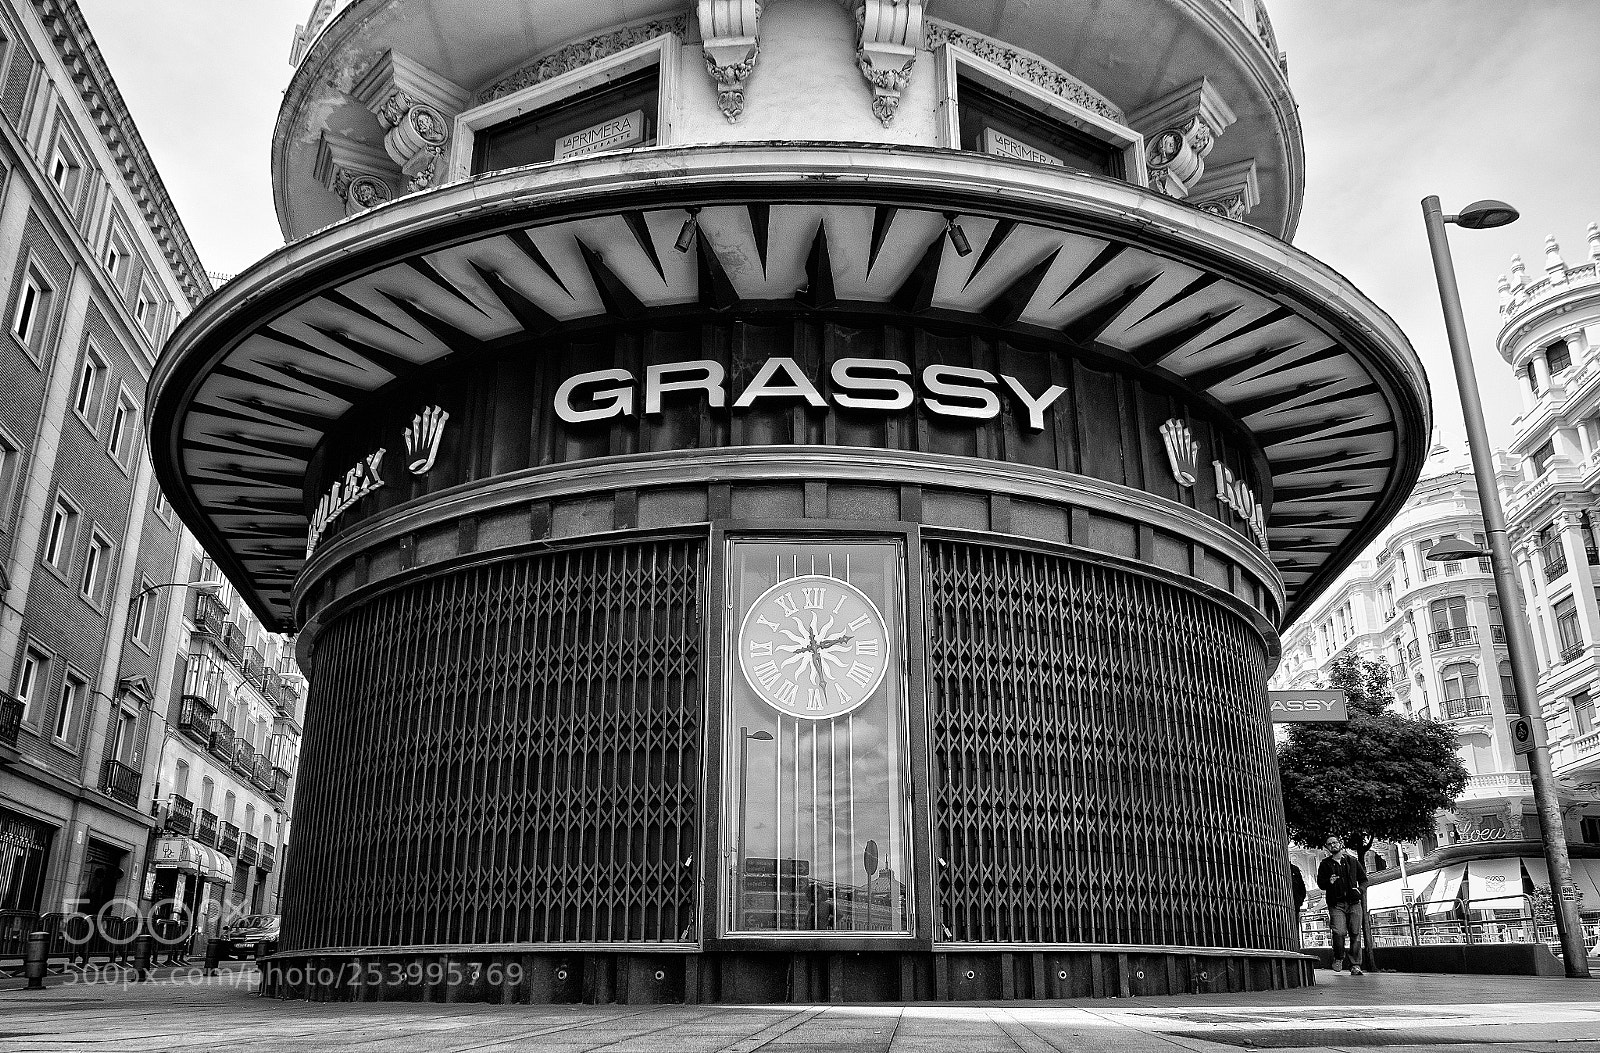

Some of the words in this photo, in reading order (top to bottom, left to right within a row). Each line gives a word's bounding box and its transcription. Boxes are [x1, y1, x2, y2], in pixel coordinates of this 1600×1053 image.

[553, 356, 1067, 431] GRASSY
[802, 587, 827, 610] XII
[756, 613, 781, 633] X
[848, 612, 872, 632] II
[855, 638, 879, 657] III
